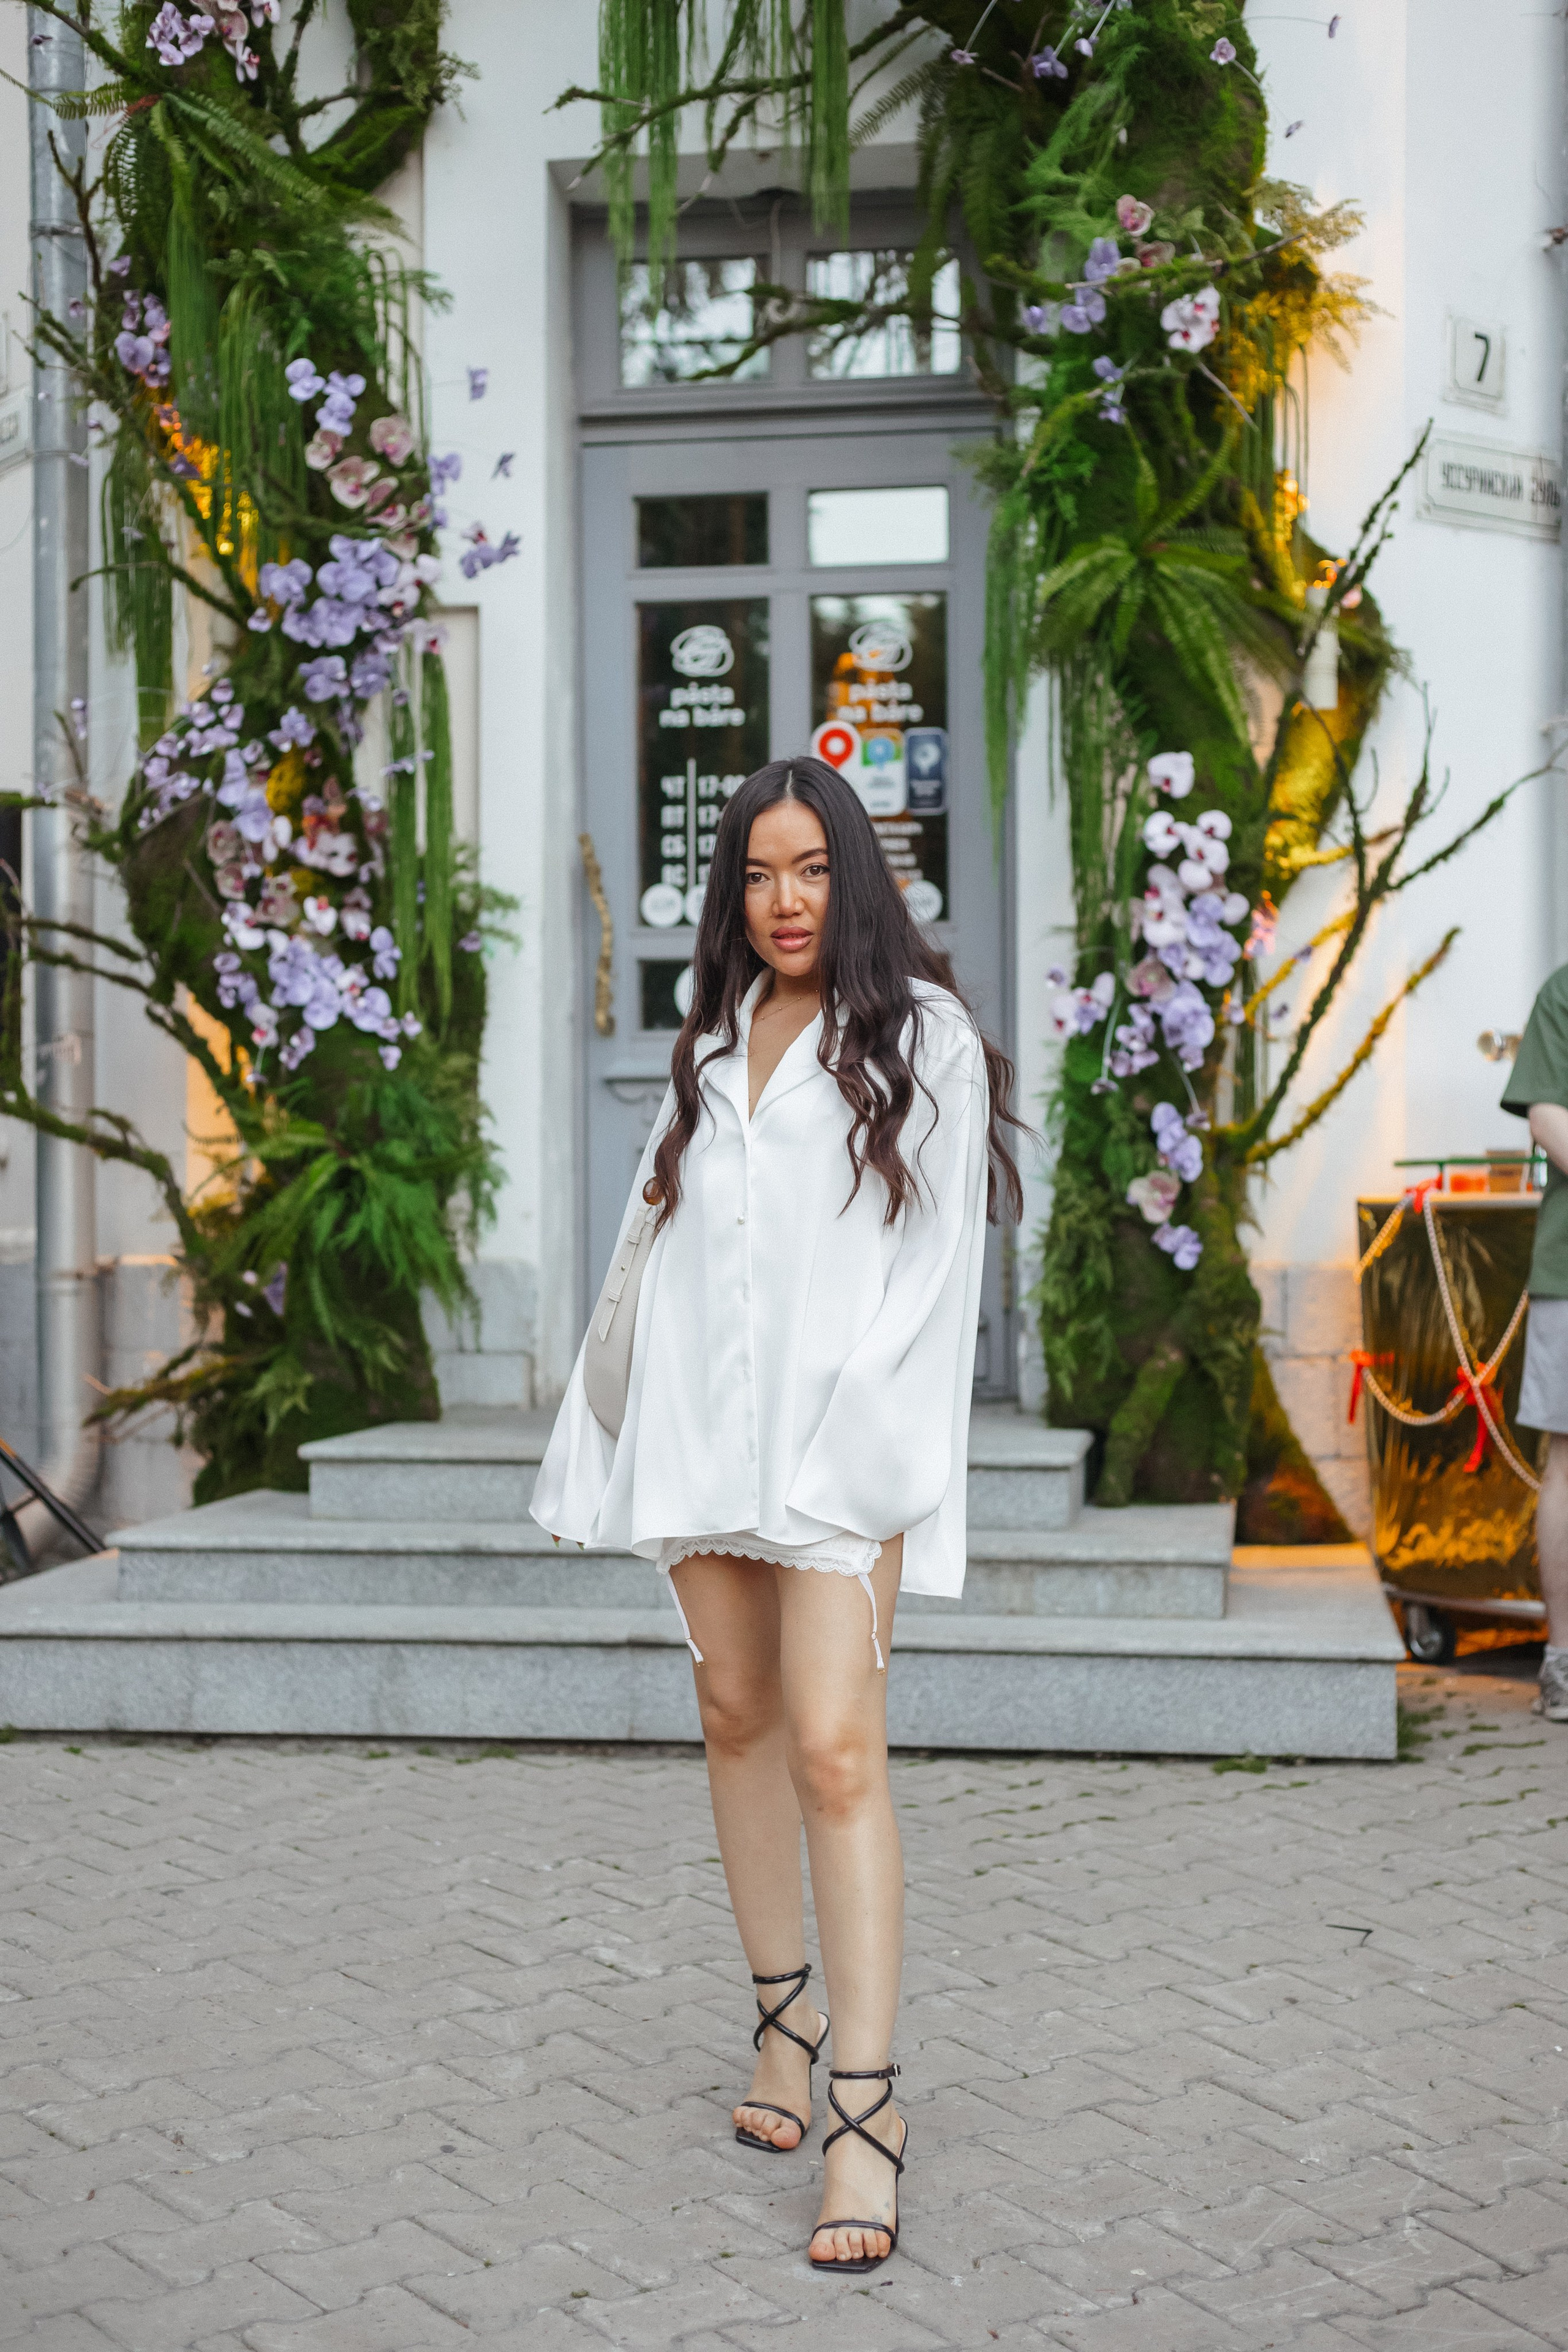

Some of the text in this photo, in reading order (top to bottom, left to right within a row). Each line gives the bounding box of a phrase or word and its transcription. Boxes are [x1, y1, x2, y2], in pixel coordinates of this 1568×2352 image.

[1474, 332, 1490, 382] 7
[661, 775, 685, 799] ЧТ
[661, 805, 685, 828] ПТ
[661, 834, 686, 858] СБ
